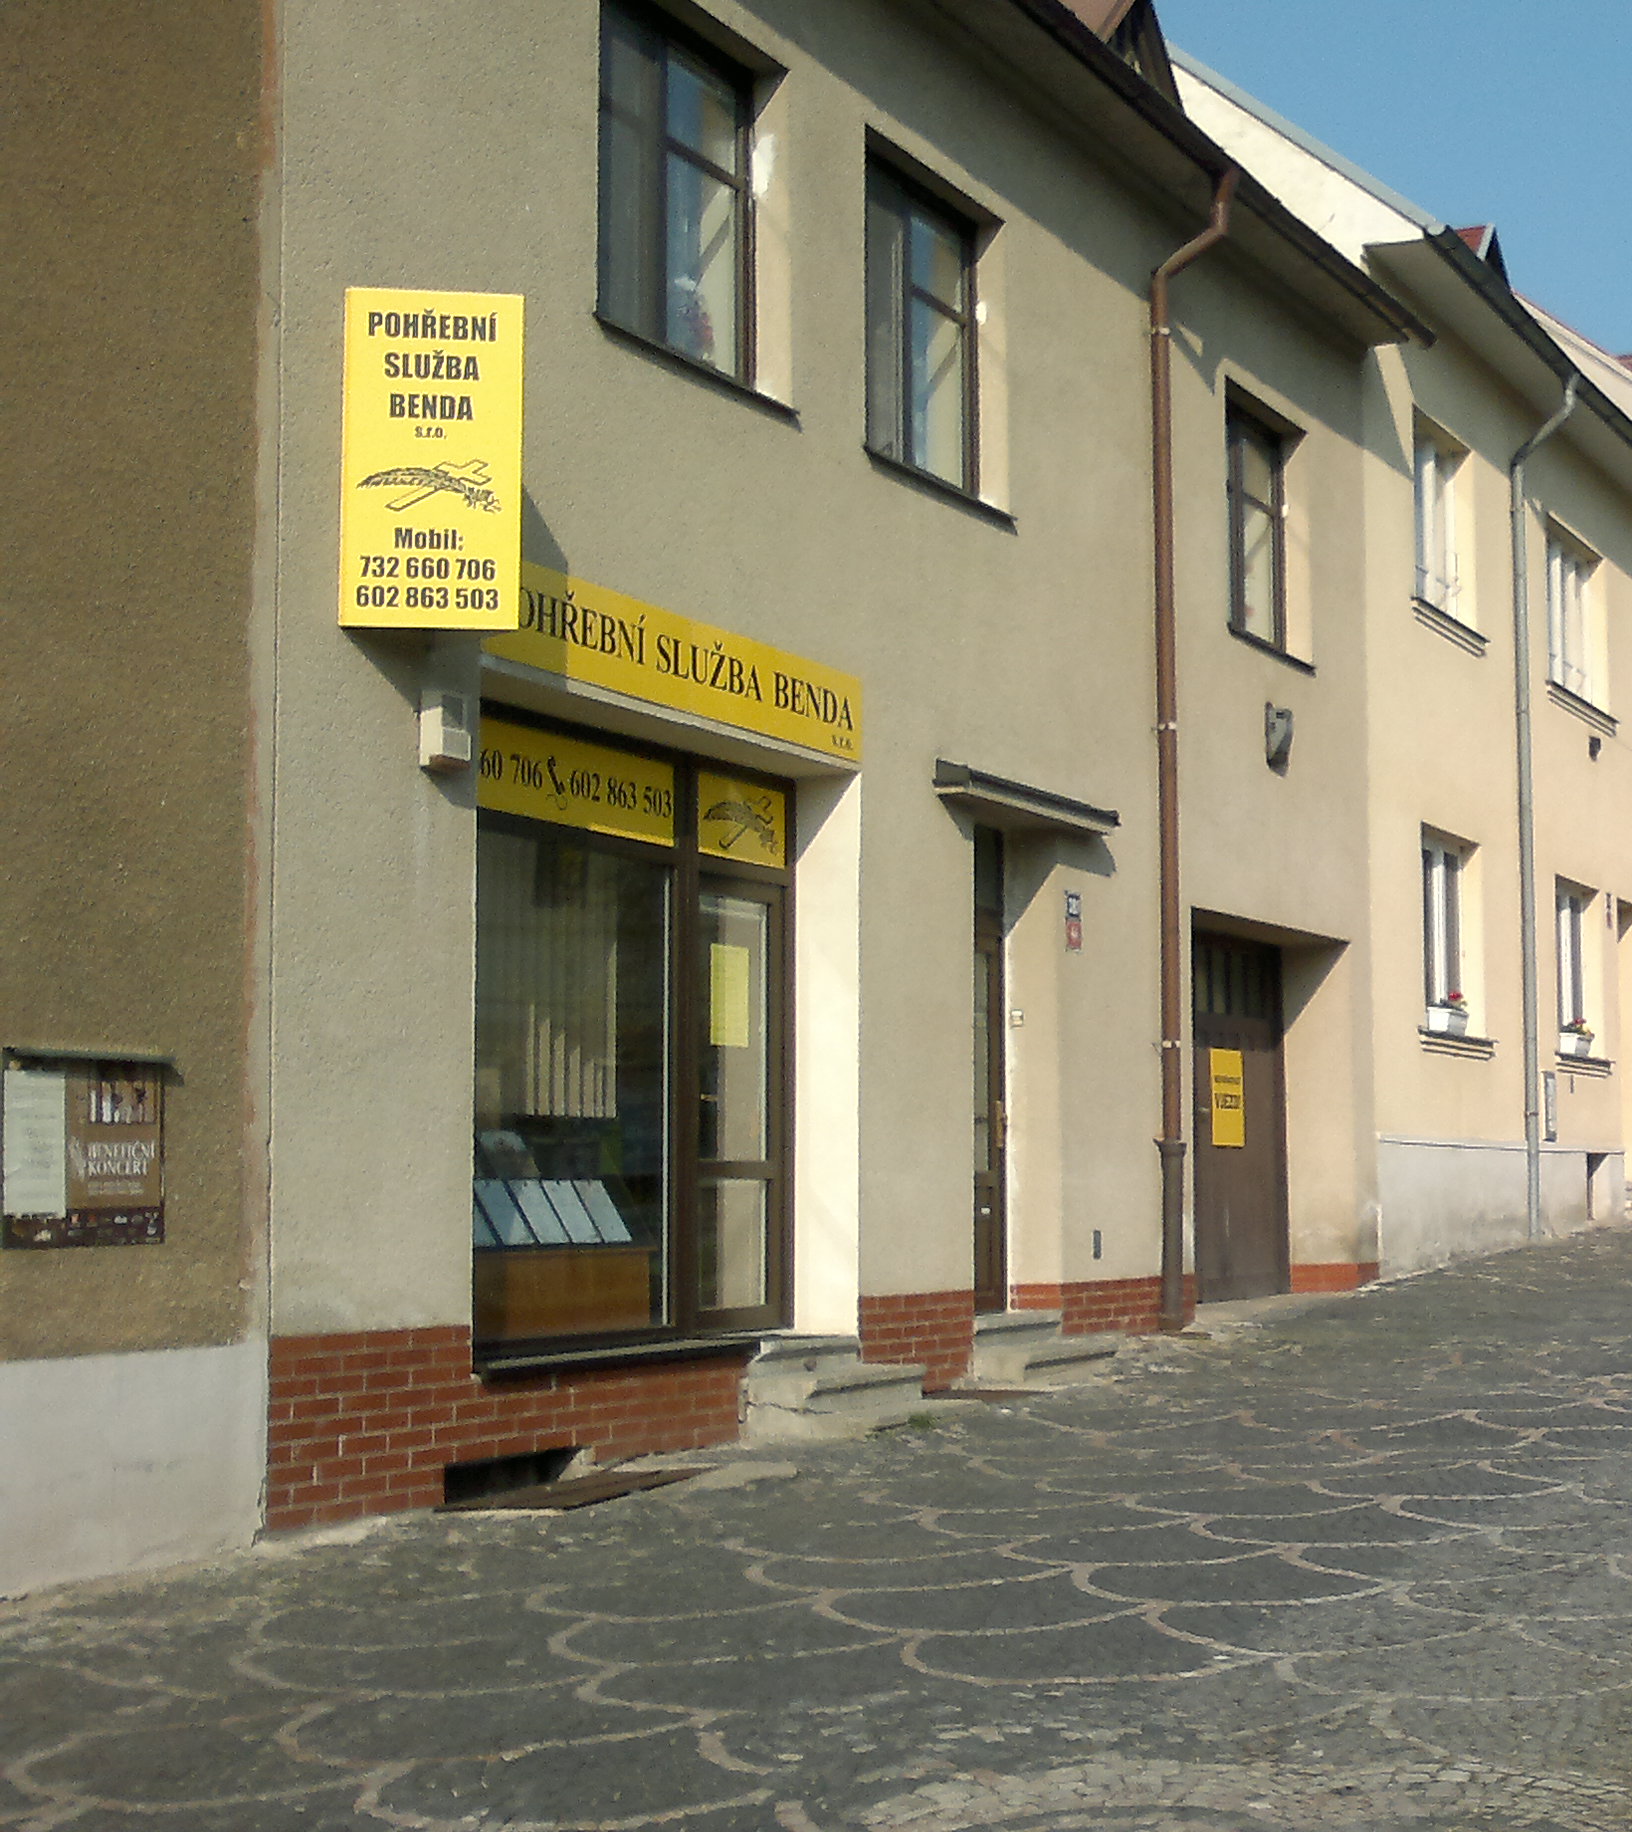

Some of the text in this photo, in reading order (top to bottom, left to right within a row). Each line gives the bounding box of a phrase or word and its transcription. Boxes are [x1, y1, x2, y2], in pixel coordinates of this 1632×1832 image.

[368, 308, 497, 342] POHŘEBNÍ
[384, 350, 479, 381] SLUŽBA
[389, 393, 474, 420] BENDA
[414, 426, 447, 440] s.r.o.
[394, 527, 463, 551] Mobil:
[360, 555, 496, 581] 732 660 706
[356, 585, 498, 611] 602 863 503
[519, 587, 853, 731] OHŘEBNÍ SLUŽBA BENDA
[479, 748, 672, 819] 60 706 602 863 503
